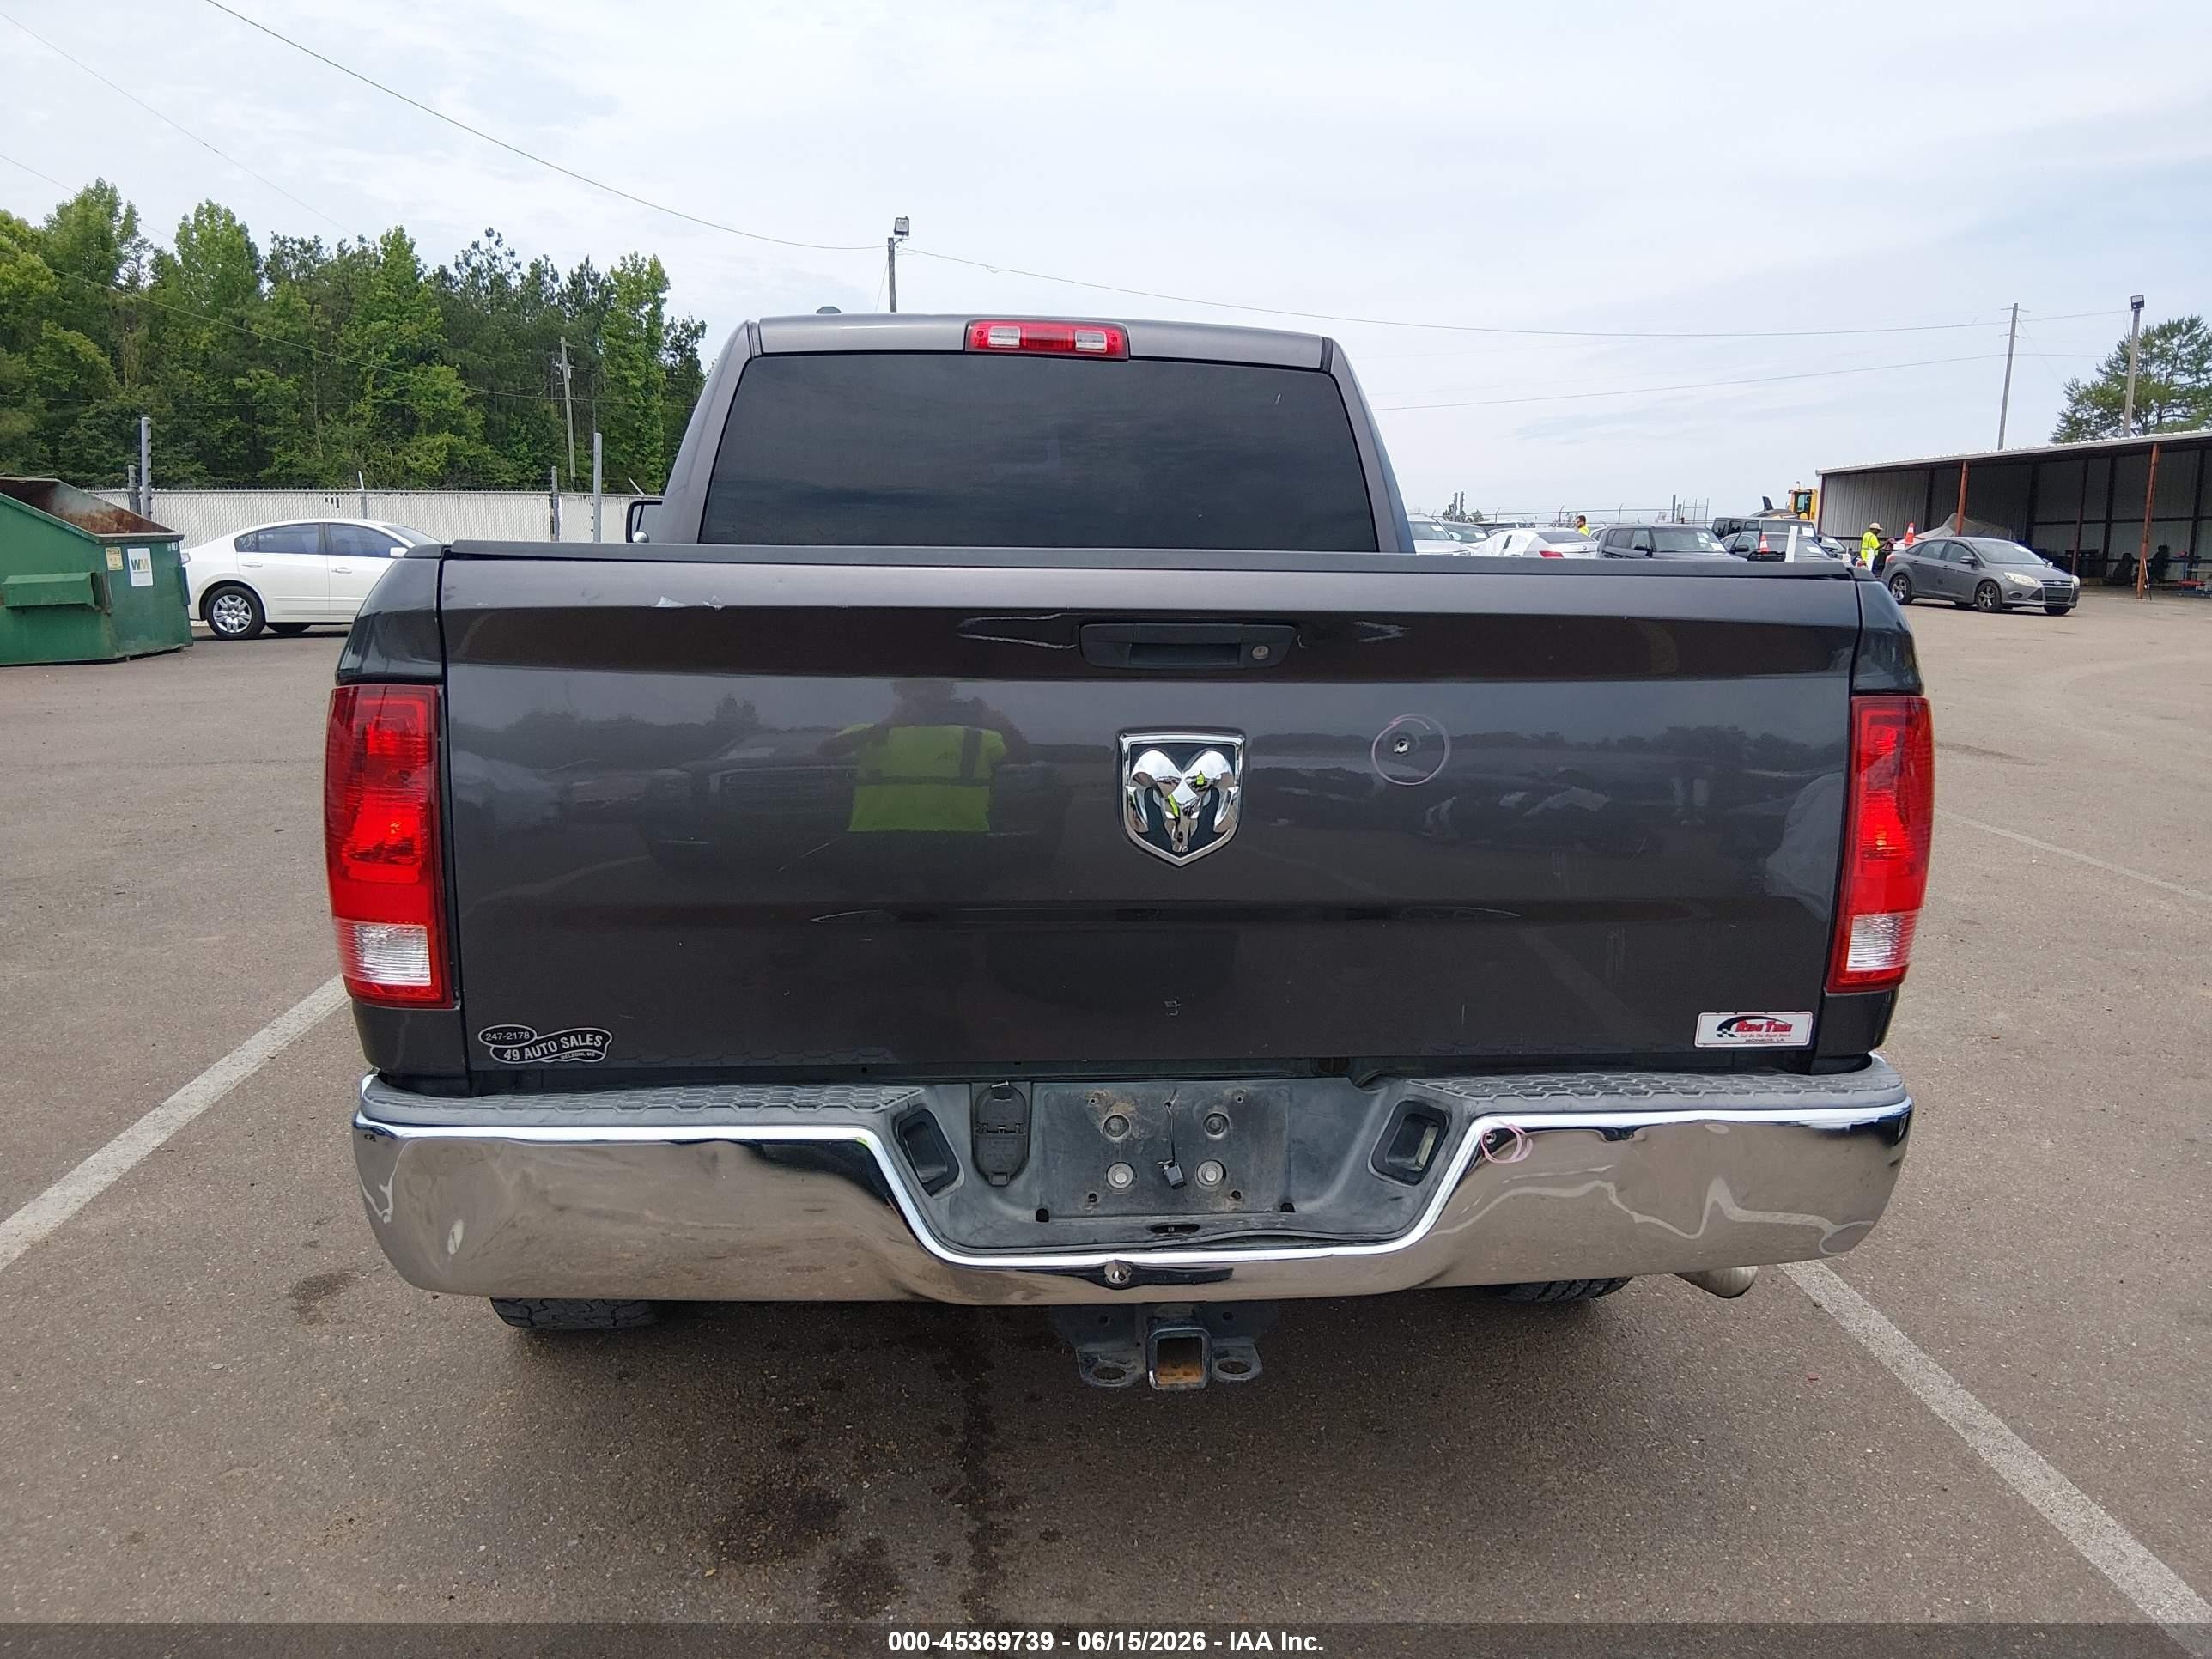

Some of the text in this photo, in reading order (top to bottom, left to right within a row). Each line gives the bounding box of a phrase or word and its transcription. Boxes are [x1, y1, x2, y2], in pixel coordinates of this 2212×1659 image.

[131, 558, 149, 570] WM
[485, 1031, 531, 1042] 247-2178
[503, 1034, 603, 1061] 49 AUTO SALES
